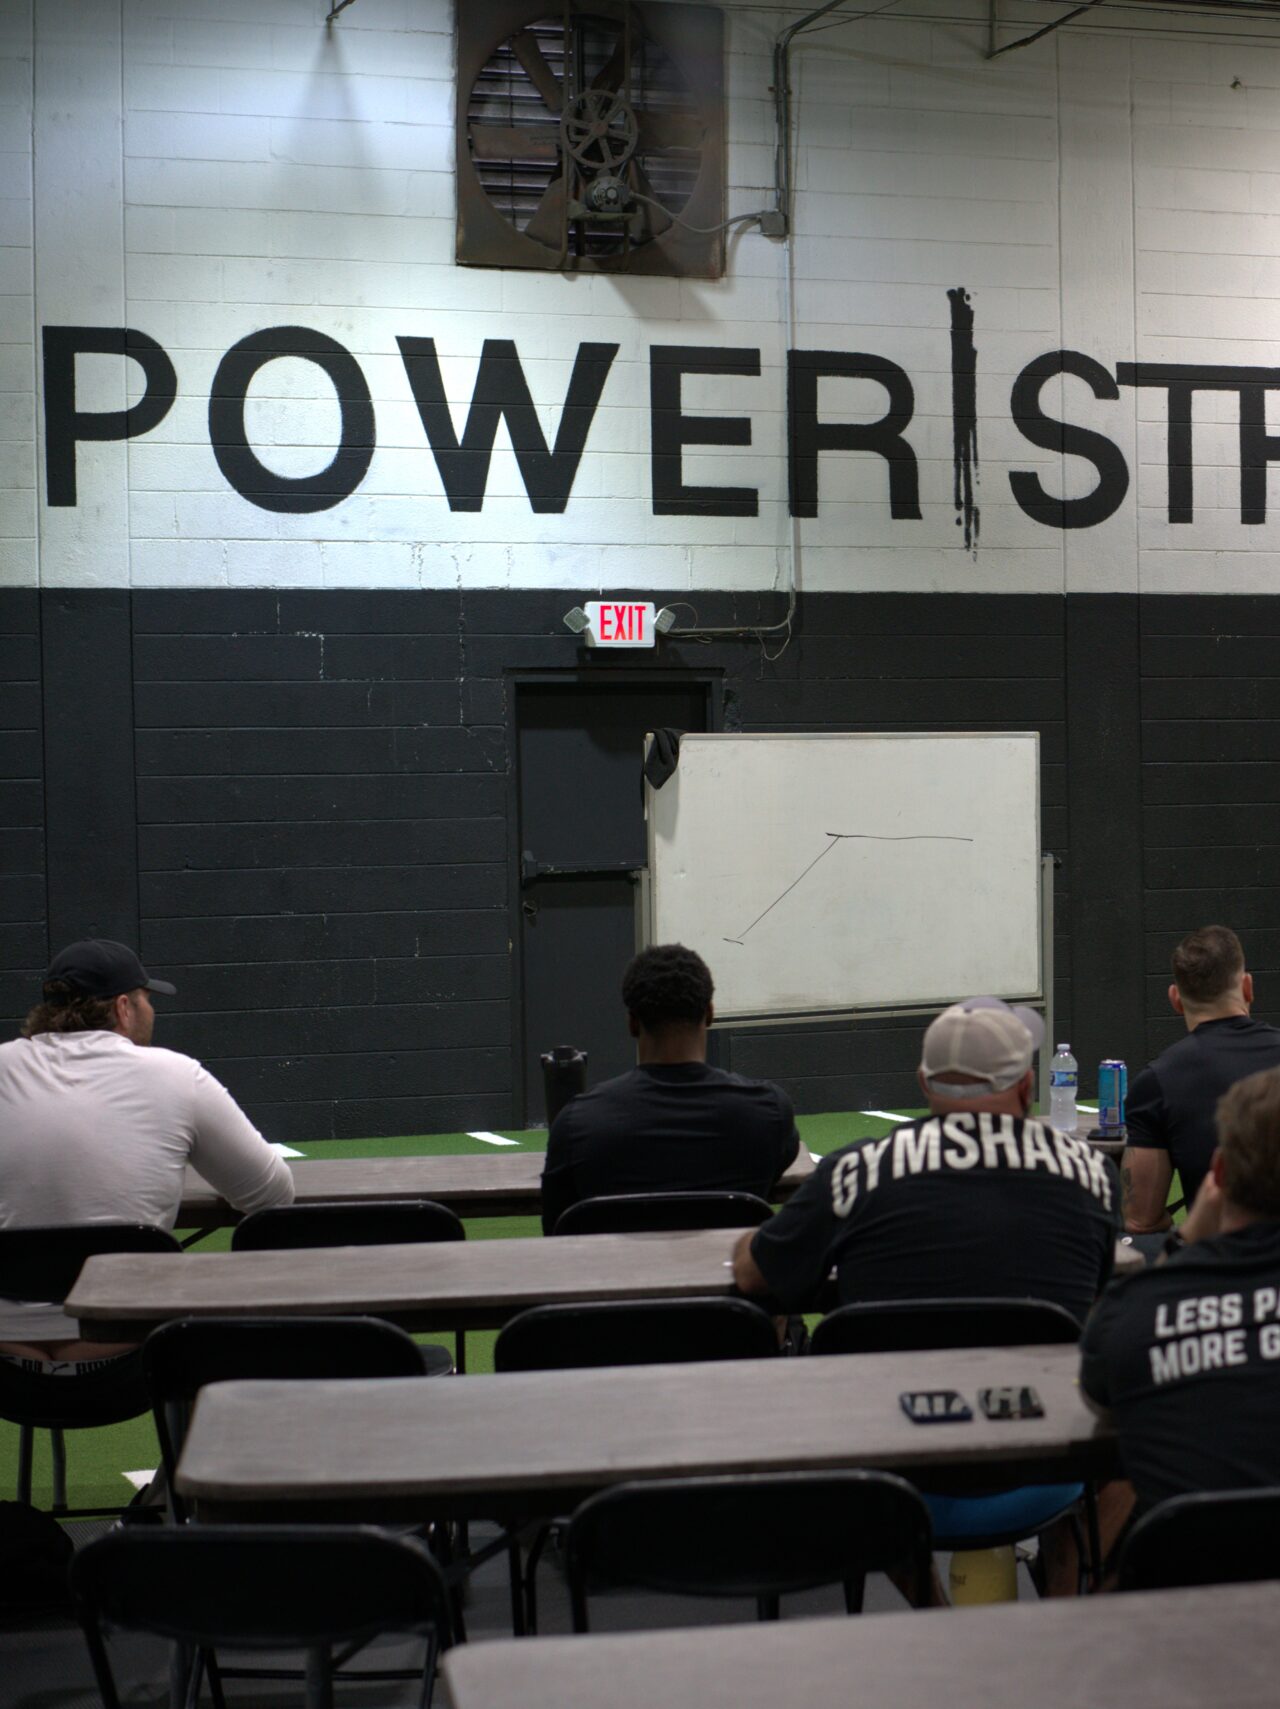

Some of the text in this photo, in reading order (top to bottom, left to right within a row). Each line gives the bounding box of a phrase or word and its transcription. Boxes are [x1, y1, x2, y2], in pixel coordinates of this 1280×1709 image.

[42, 325, 923, 521] POWER
[600, 605, 646, 640] EXIT
[831, 1112, 1113, 1219] GYMSHARK
[1154, 1292, 1243, 1339] LESS
[1148, 1328, 1248, 1386] MORE
